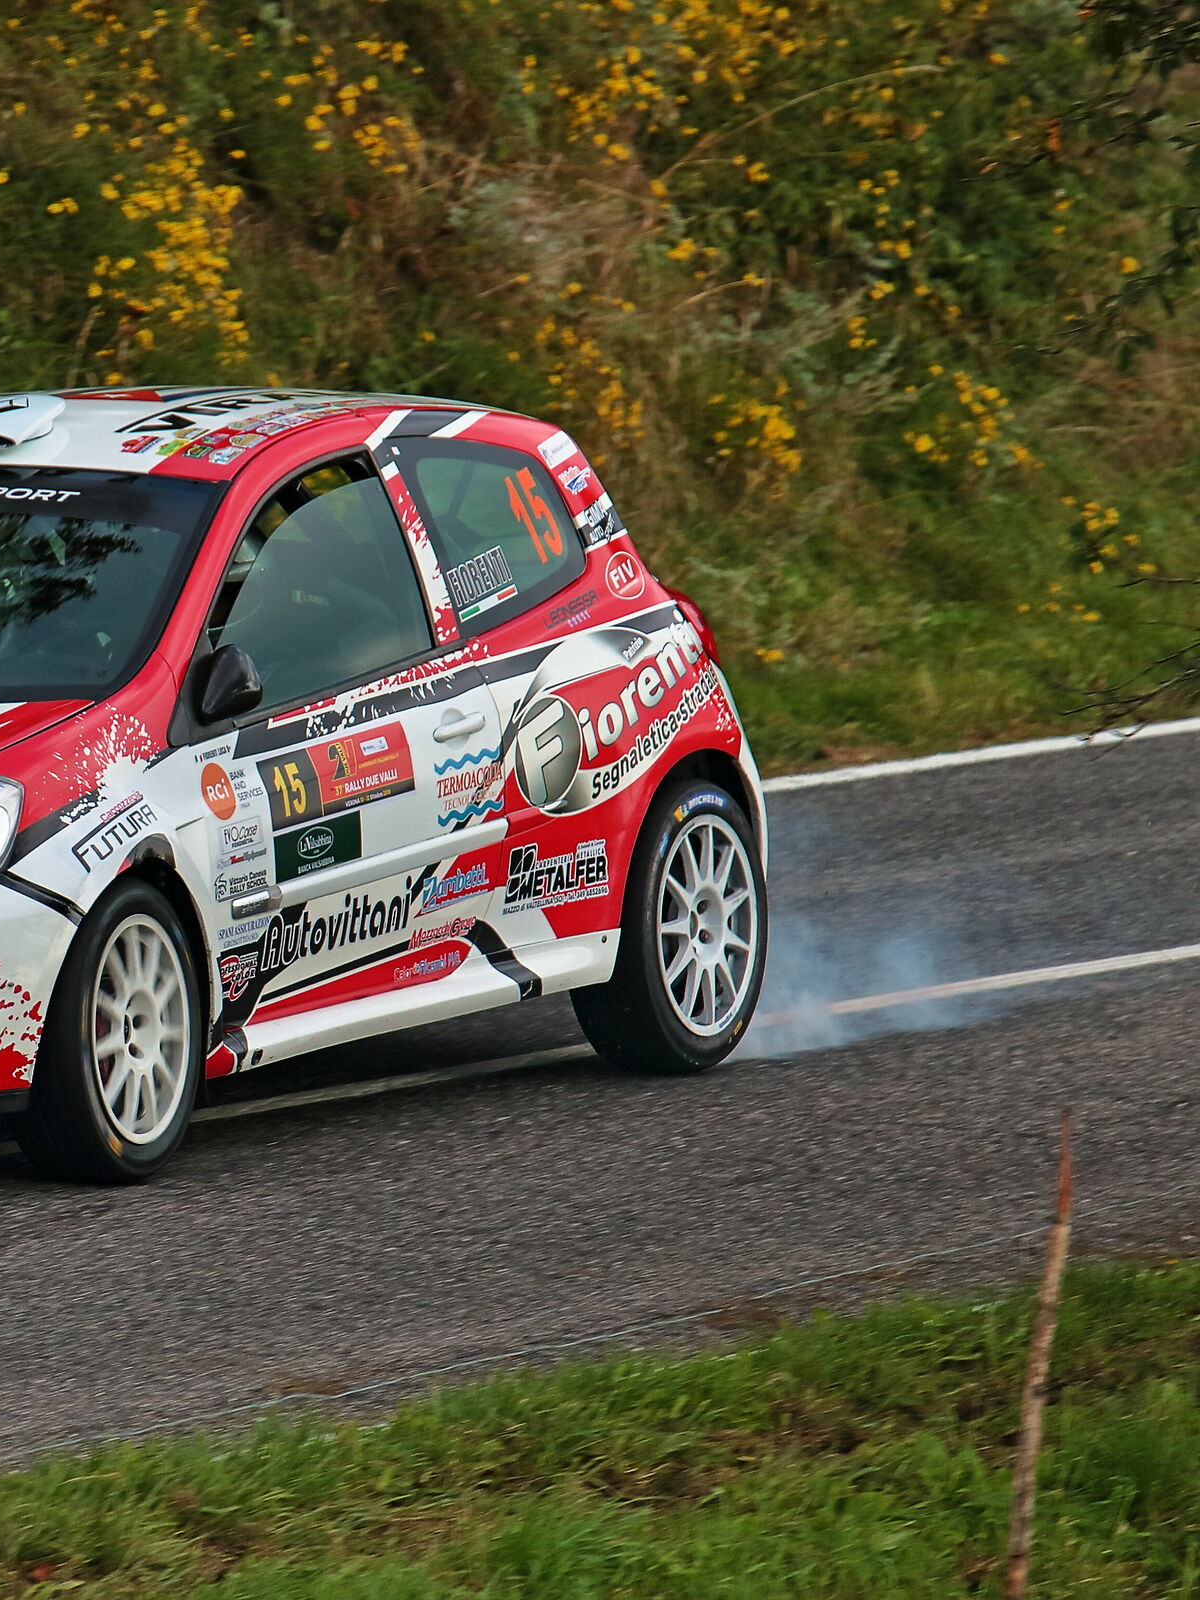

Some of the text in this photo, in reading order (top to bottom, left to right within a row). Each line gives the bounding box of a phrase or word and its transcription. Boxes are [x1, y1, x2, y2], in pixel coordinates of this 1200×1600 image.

[504, 466, 564, 564] 15
[446, 545, 512, 607] FIORENTI
[609, 558, 634, 589] FIV
[544, 590, 597, 629] LEONESSA
[516, 609, 704, 807] Fiorenti
[206, 778, 229, 802] RCi
[230, 769, 246, 780] BANK
[233, 780, 246, 790] AND
[273, 762, 307, 817] 15
[344, 777, 365, 793] RALLY
[365, 774, 379, 788] DUE
[379, 769, 398, 783] VALLI
[437, 763, 502, 798] TERMOACQUA
[237, 787, 264, 802] SERVICES
[71, 800, 158, 874] FUTURA
[229, 877, 267, 895] RALLY SCHOOL
[518, 855, 607, 900] METALFER
[260, 875, 412, 972] Autovittani
